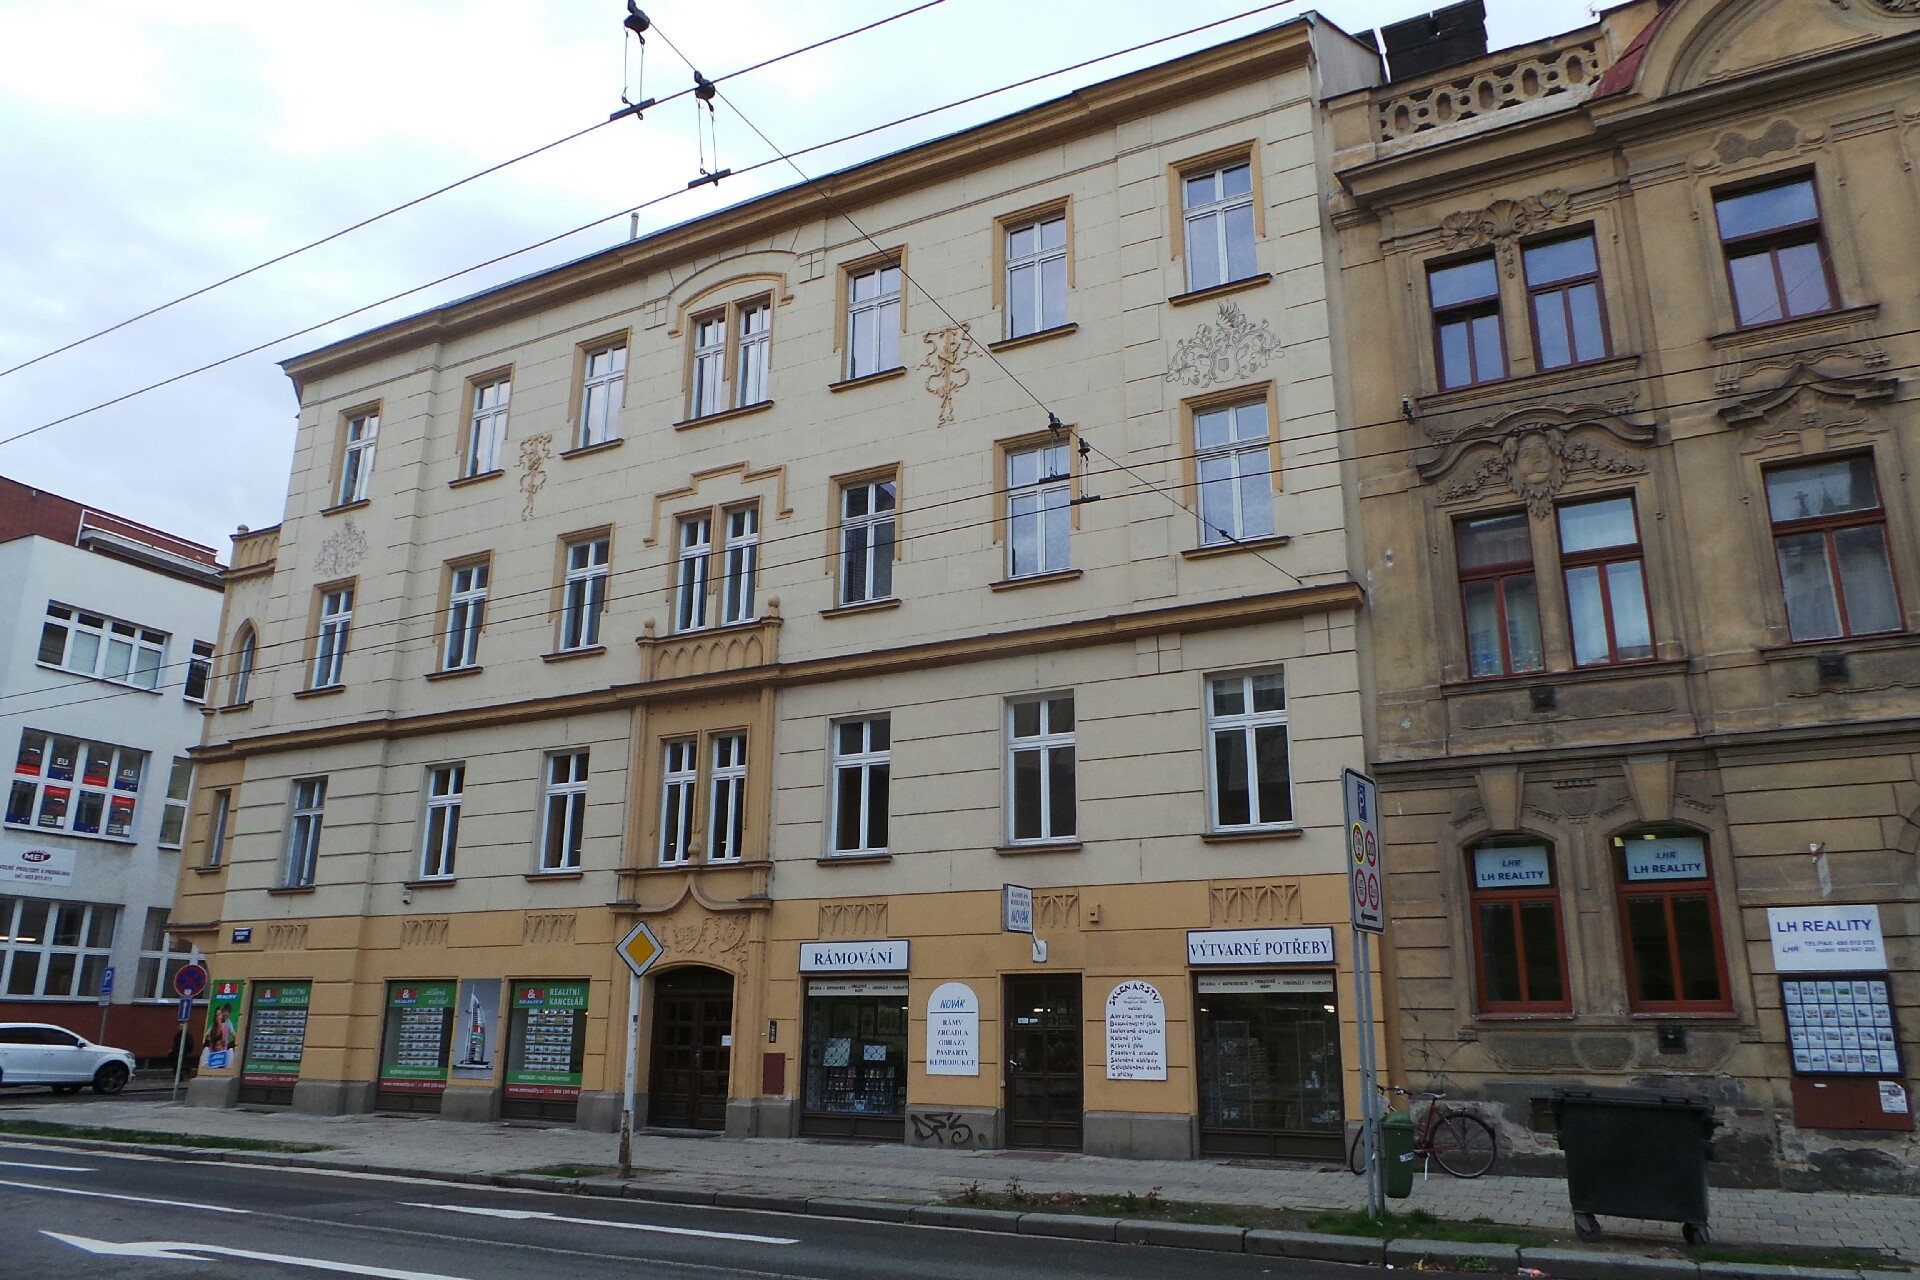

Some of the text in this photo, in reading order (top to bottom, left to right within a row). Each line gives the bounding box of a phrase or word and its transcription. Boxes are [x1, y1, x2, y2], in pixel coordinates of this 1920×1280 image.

[57, 757, 69, 766] EU
[24, 853, 44, 861] MEI
[1656, 851, 1676, 859] LHR
[1502, 859, 1521, 867] LHR
[1634, 863, 1700, 874] LH REALITY
[1481, 871, 1544, 881] LH REALITY
[1777, 920, 1872, 932] LH REALITY
[1190, 938, 1330, 957] VÝTVARNÉ POTŘEBY
[814, 948, 893, 965] RÁMOVÁNÍ
[104, 970, 112, 986] P
[549, 988, 580, 996] REALITNÍ
[1109, 982, 1161, 1006] SKLENÁŘSTVÍ
[549, 998, 584, 1006] KANCELÁŘ
[940, 997, 965, 1009] NOVÁK
[942, 1018, 962, 1026] RÁMY
